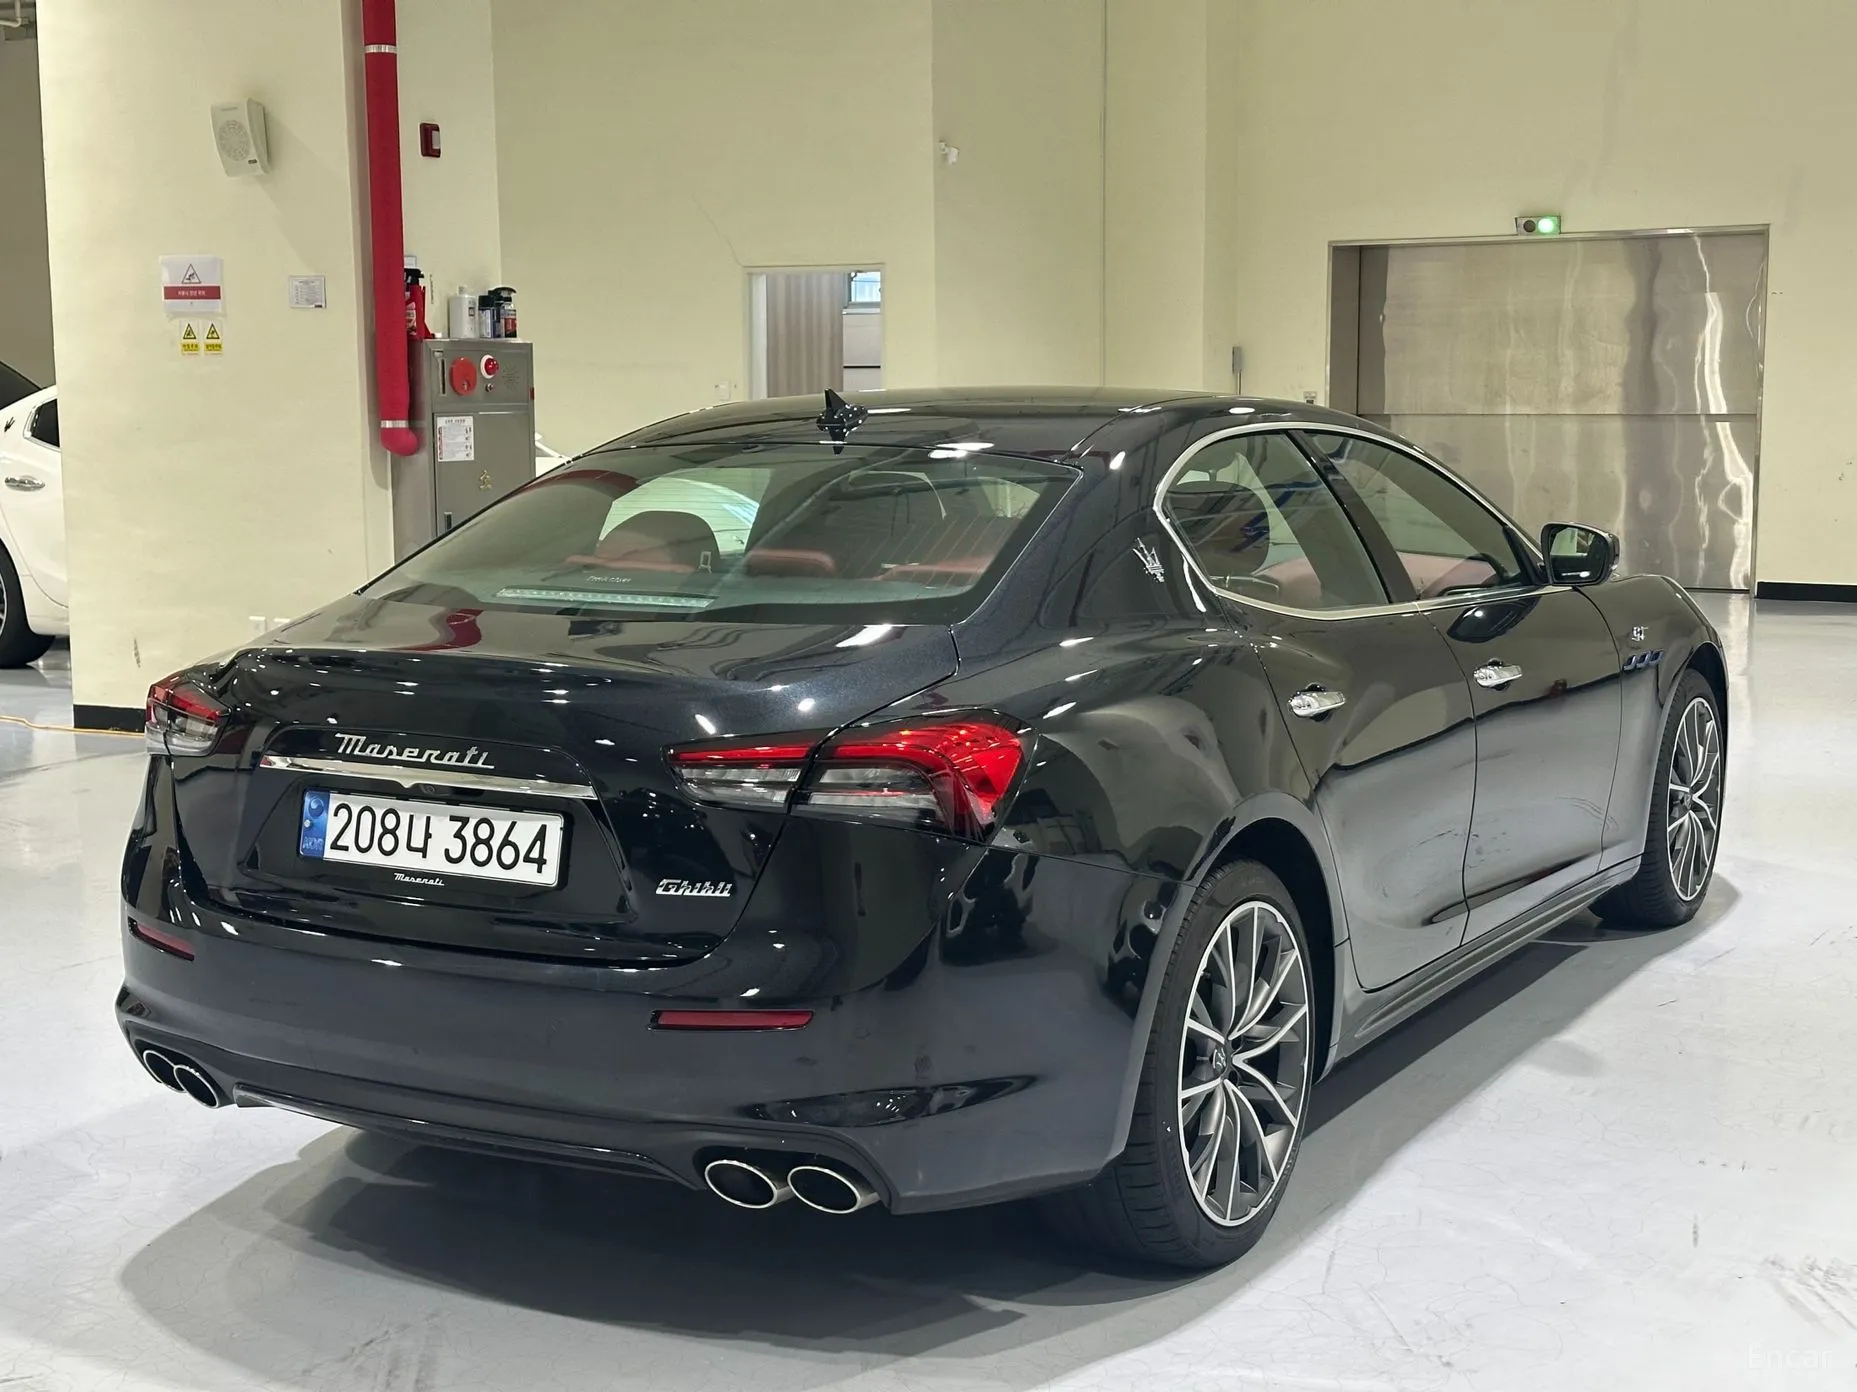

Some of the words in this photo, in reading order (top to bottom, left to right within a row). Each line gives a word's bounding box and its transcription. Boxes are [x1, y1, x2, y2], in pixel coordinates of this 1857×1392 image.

[335, 733, 494, 769] Maserati
[330, 803, 432, 858] 208나
[444, 815, 547, 873] 3864
[394, 872, 444, 886] Maserati
[656, 879, 732, 897] Ghibli
